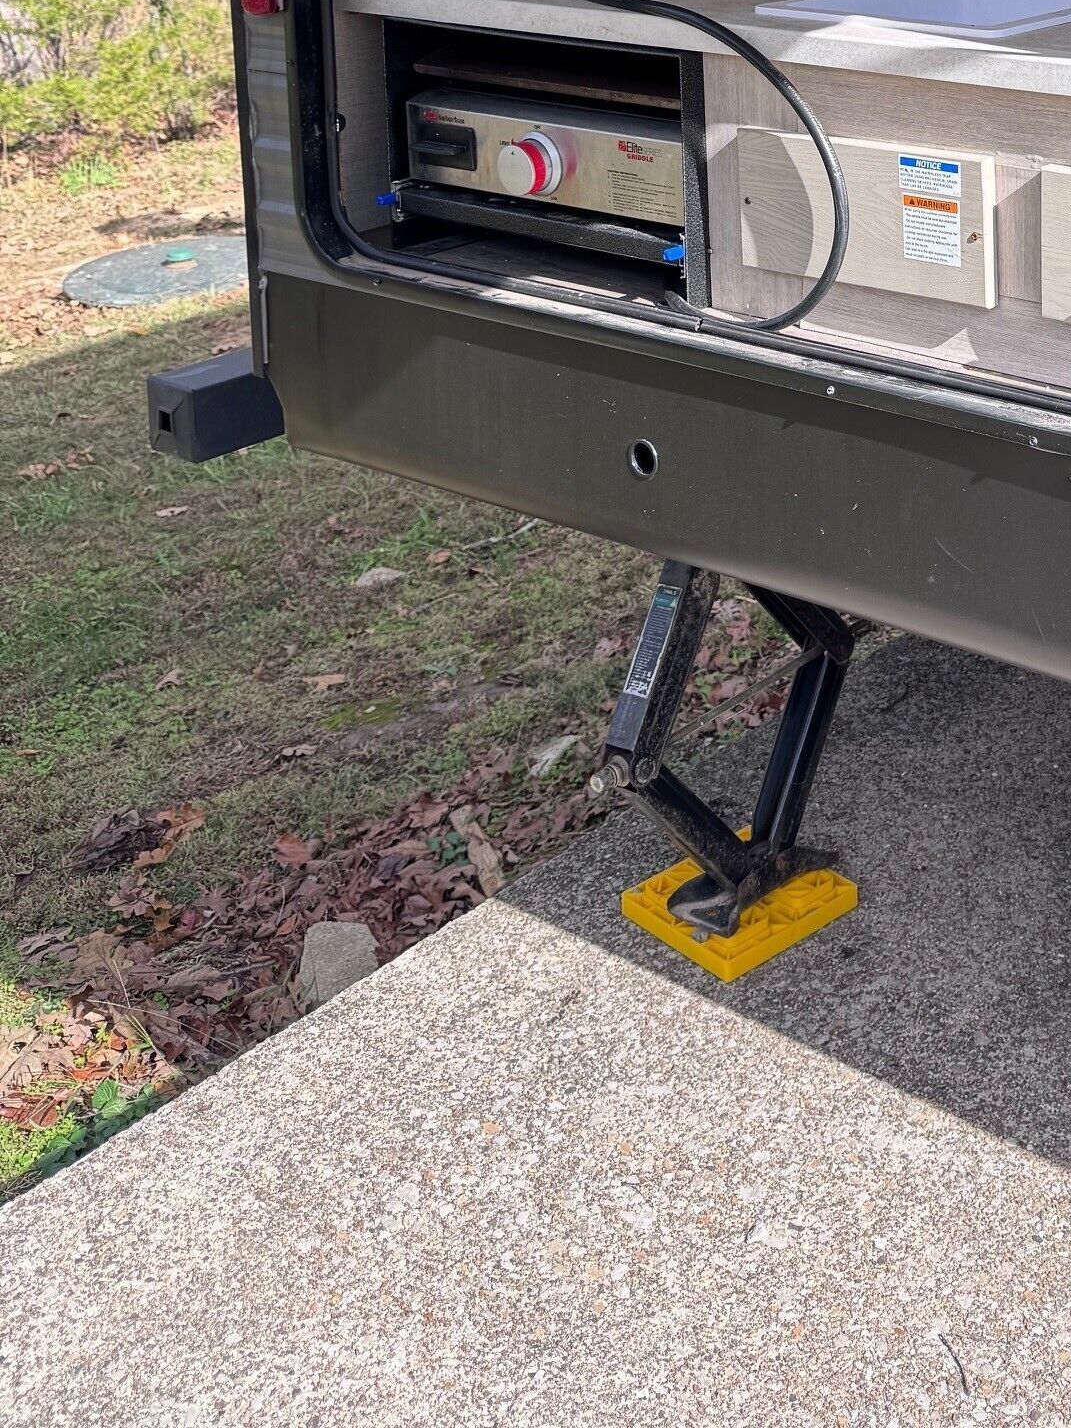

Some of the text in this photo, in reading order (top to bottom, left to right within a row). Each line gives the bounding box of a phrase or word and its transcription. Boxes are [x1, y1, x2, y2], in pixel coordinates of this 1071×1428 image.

[627, 153, 653, 162] GRIDDLE
[916, 159, 942, 170] NOTICE
[916, 198, 951, 211] WARNING
